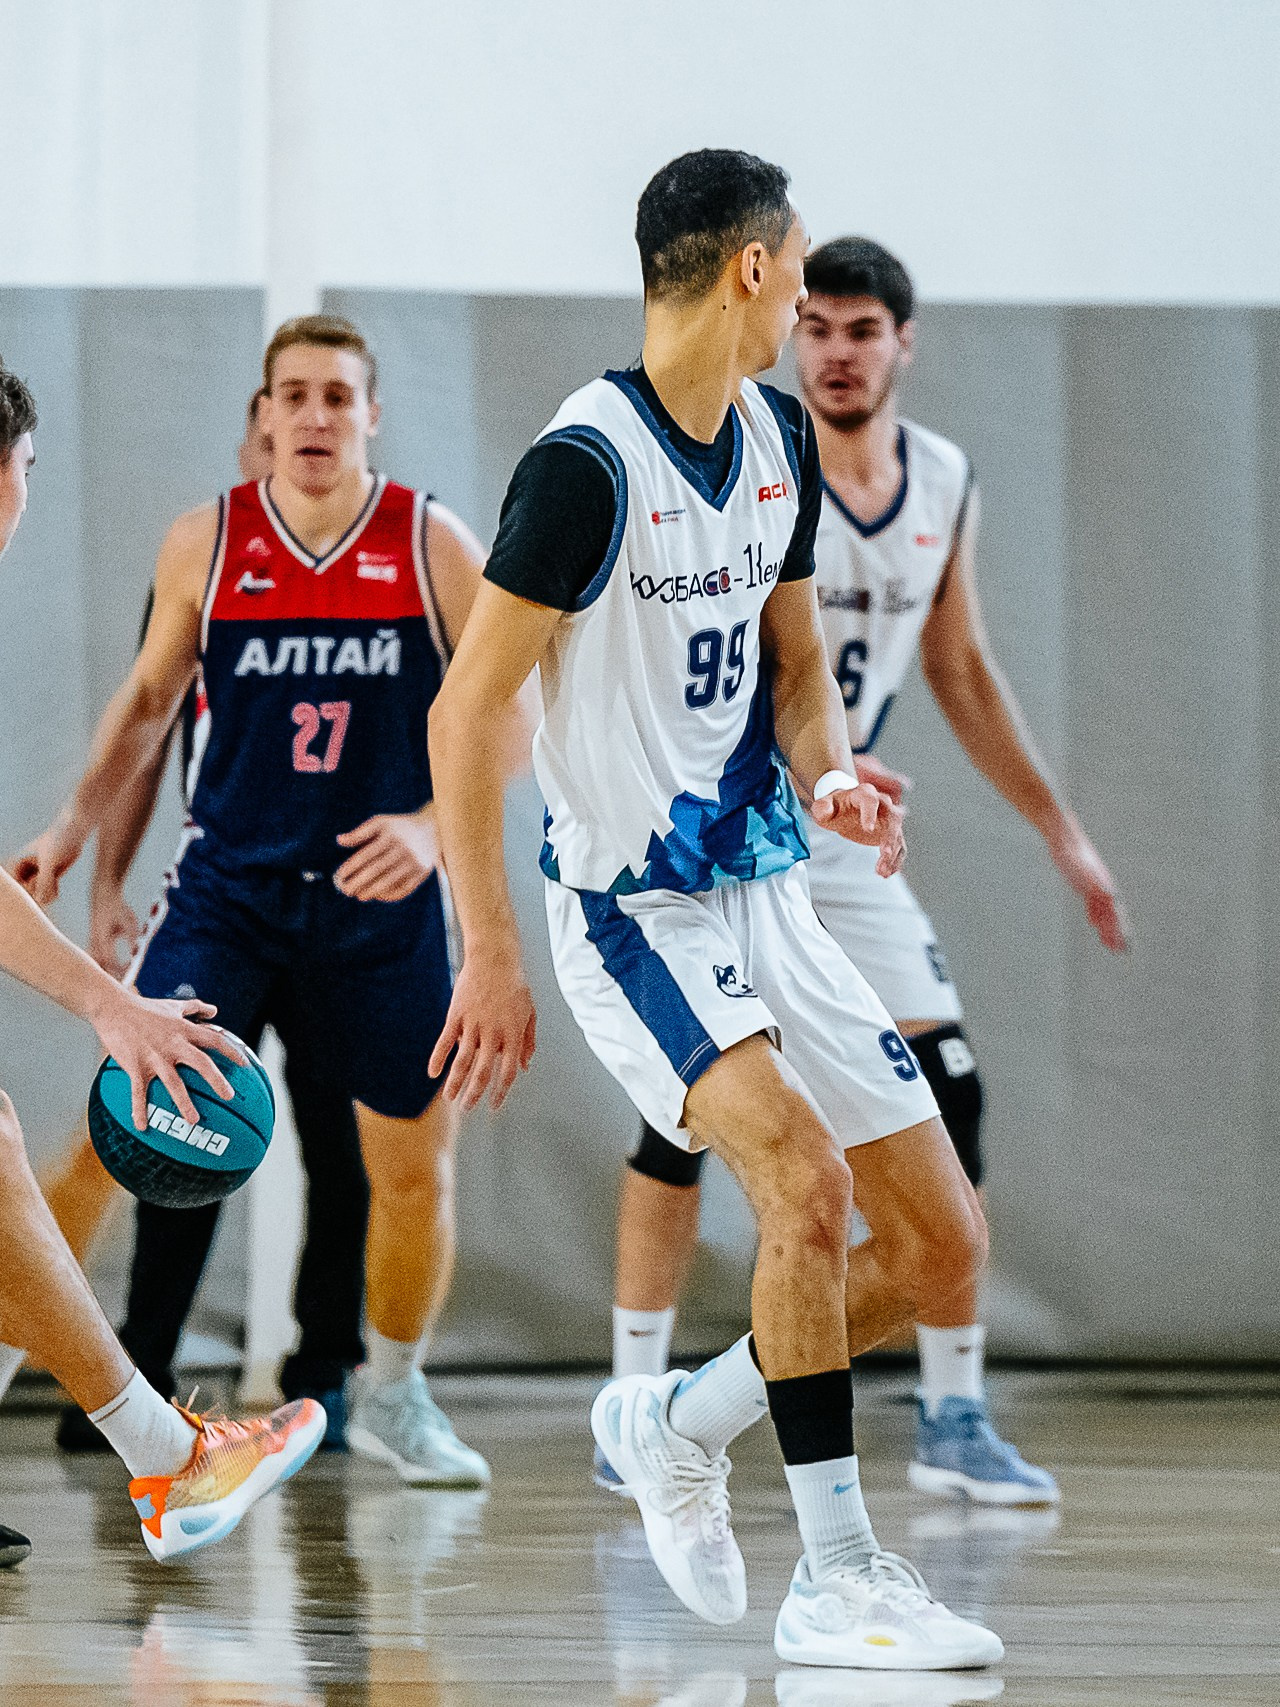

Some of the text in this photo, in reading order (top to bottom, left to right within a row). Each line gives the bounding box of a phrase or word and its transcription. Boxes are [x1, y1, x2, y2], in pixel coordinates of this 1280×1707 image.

[757, 481, 788, 503] АС
[234, 628, 402, 676] АЛТАЙ
[684, 618, 750, 712] 99
[291, 700, 352, 773] 27
